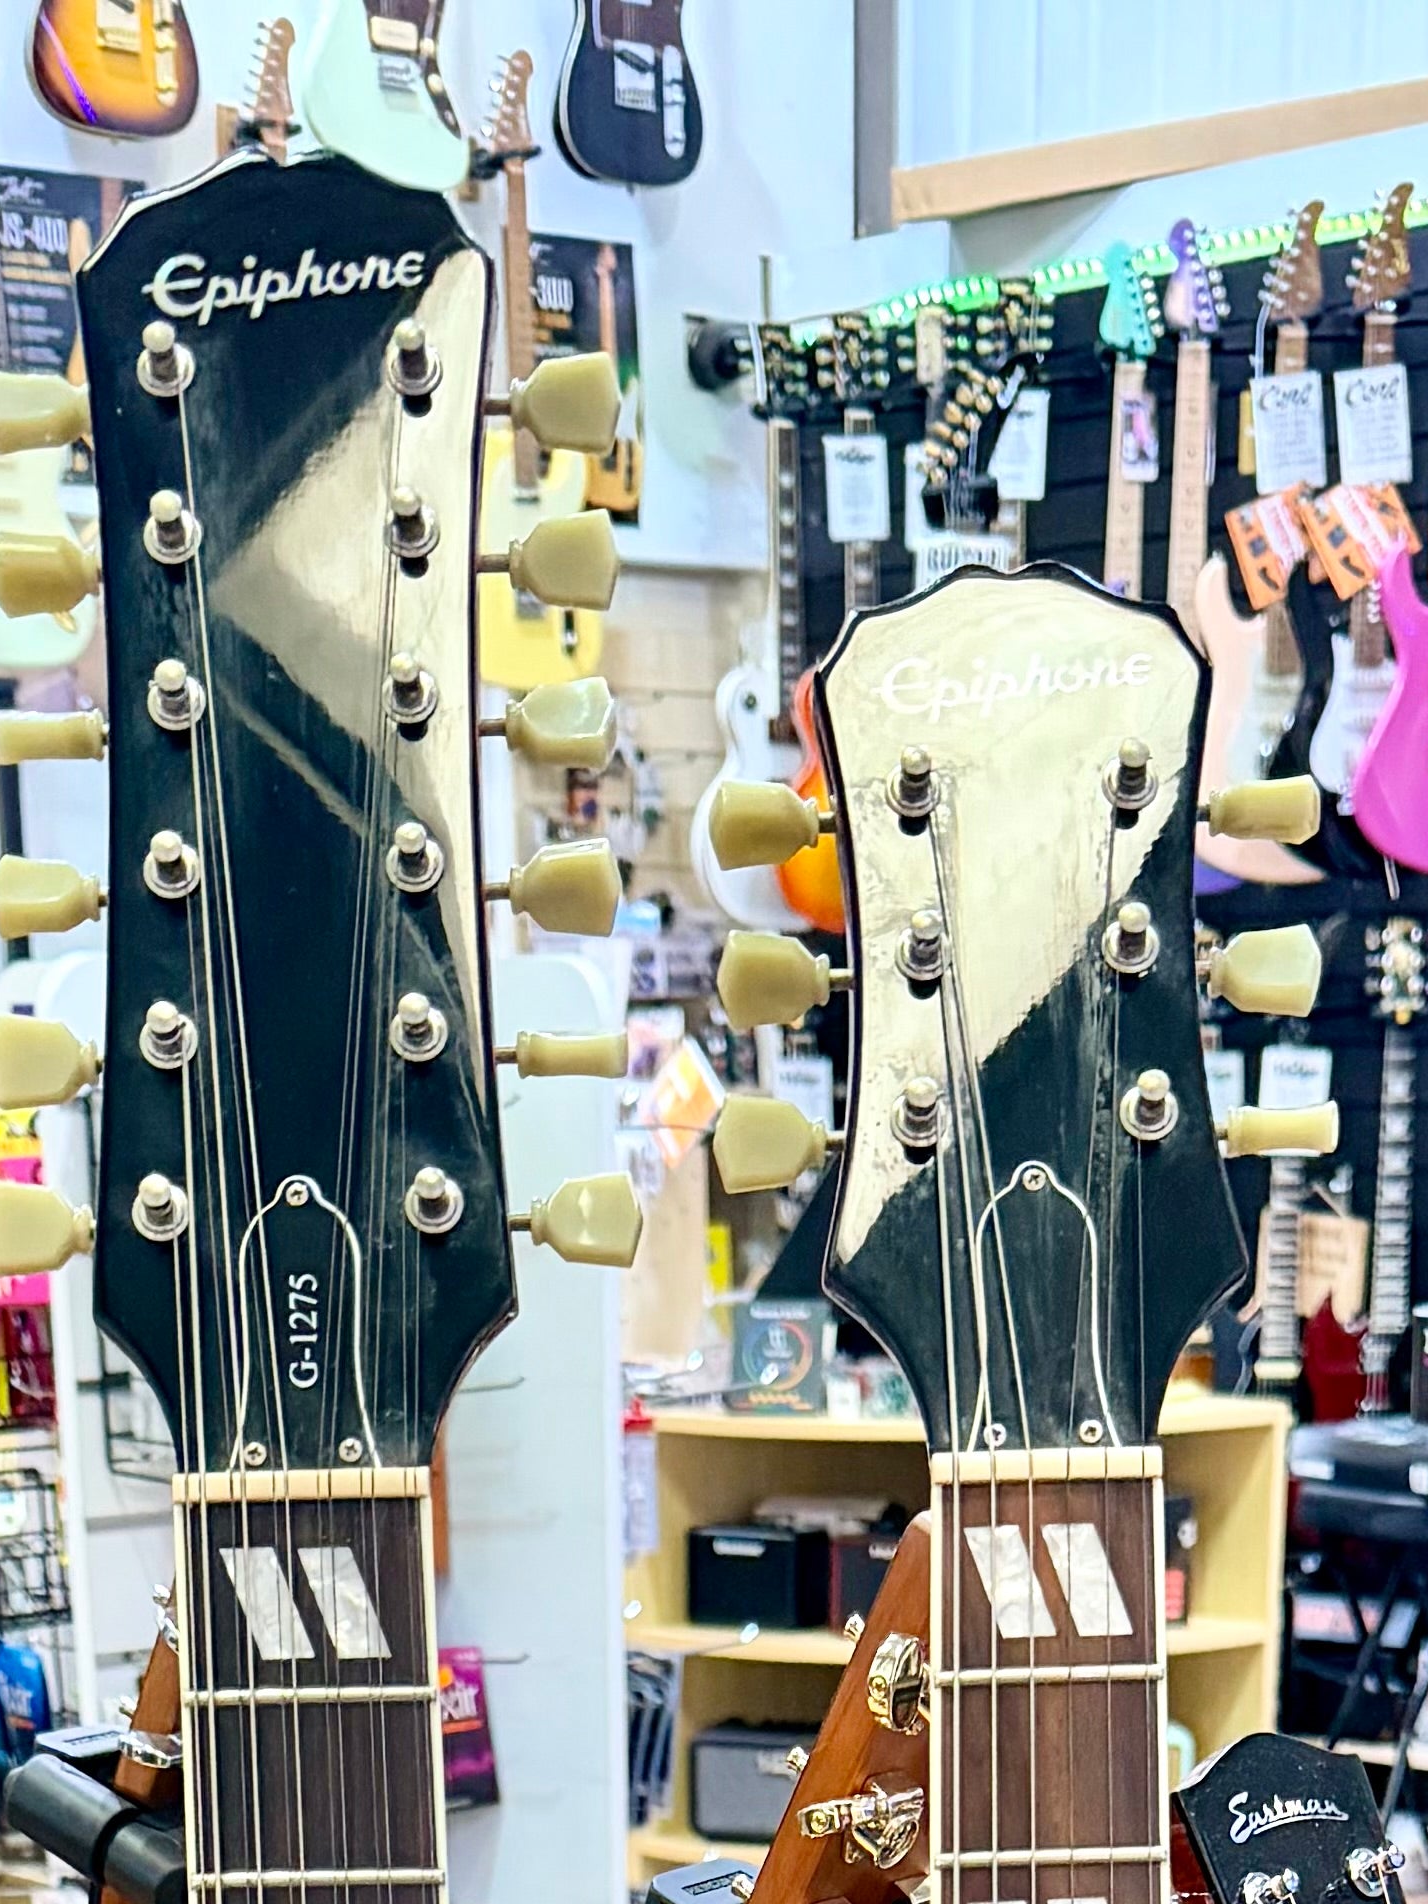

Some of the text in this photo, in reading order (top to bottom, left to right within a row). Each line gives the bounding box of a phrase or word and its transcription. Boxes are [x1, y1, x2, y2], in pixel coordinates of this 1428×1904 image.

[142, 249, 427, 326] Epiphone
[873, 652, 1154, 723] Epiphone
[289, 1272, 318, 1389] G-1275
[1228, 1791, 1350, 1844] Eastman
